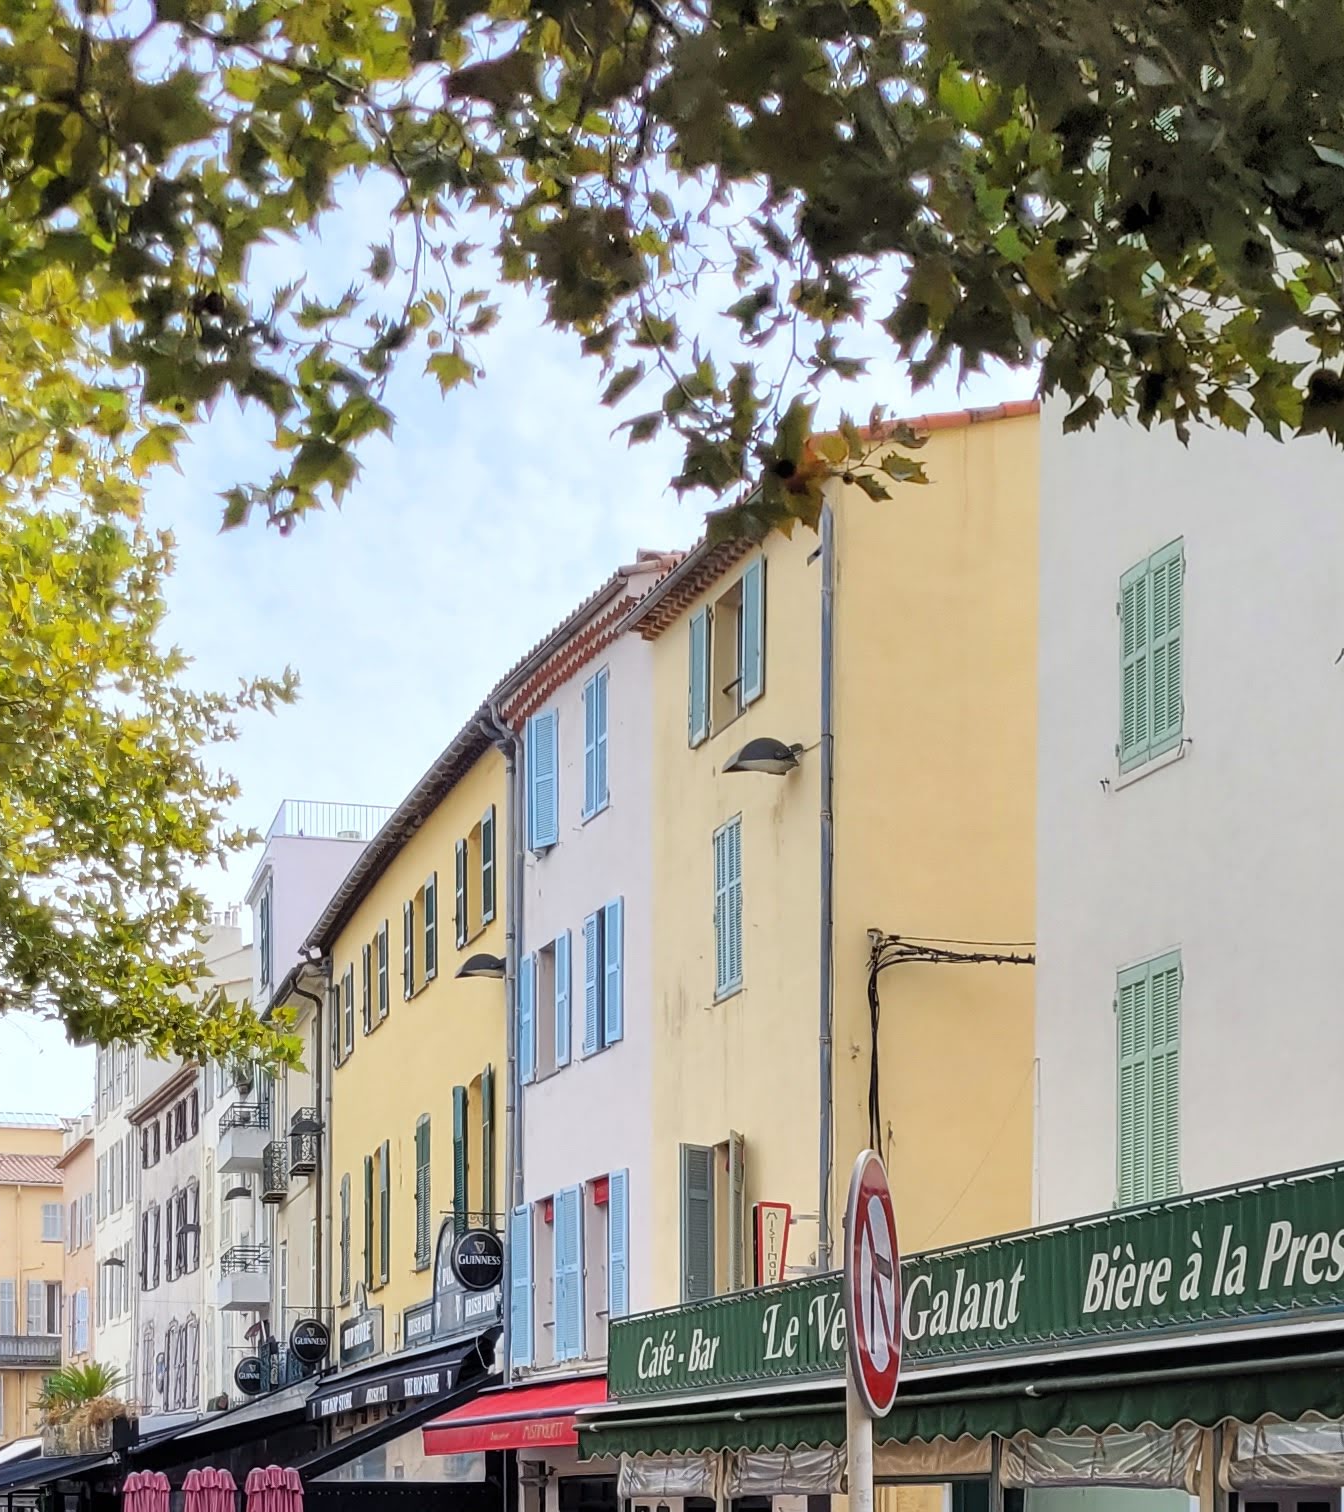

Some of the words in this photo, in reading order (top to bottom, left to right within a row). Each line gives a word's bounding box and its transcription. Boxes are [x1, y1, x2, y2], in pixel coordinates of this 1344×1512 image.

[458, 1253, 501, 1265] GUINNESS
[638, 1330, 676, 1380] Café
[688, 1328, 721, 1373] Bar
[762, 1303, 800, 1361] Le
[808, 1293, 845, 1353] Ve
[902, 1258, 1027, 1341] Galant
[1082, 1242, 1172, 1314] Bière
[1179, 1230, 1204, 1302] à
[1211, 1224, 1248, 1297] la
[294, 1336, 327, 1345] GUINNESS
